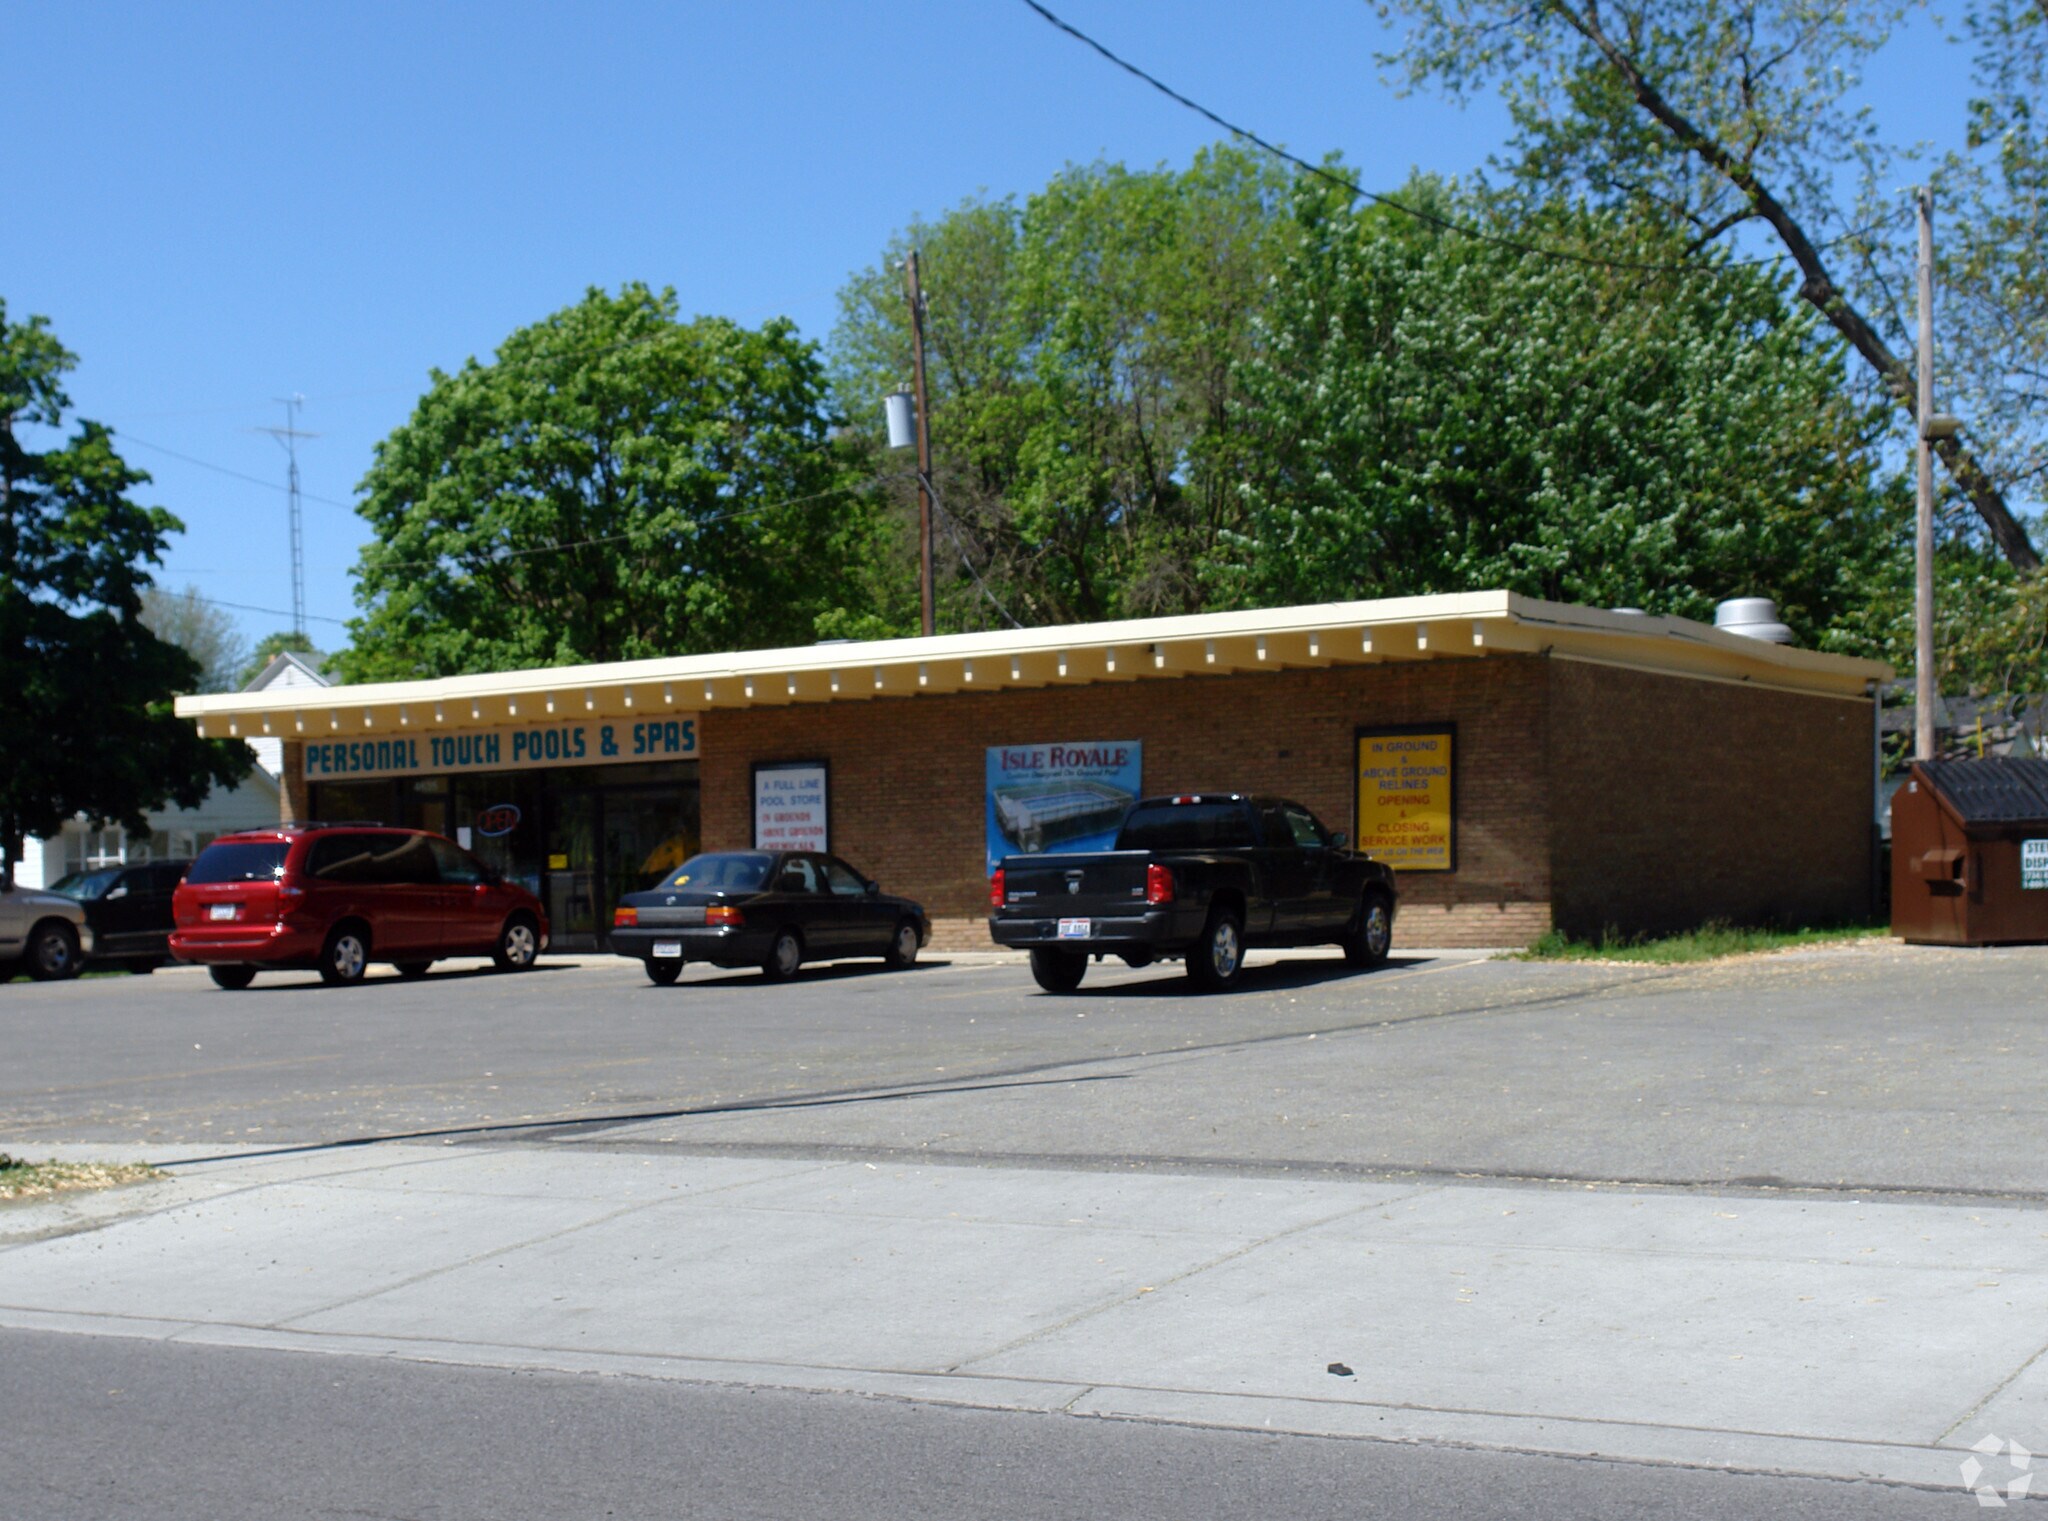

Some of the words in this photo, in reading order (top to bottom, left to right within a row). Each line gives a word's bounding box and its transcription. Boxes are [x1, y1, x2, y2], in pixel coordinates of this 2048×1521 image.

[306, 739, 419, 775] PERSONAL
[431, 733, 500, 767] TOUCH
[513, 726, 586, 762] POOLS
[601, 725, 619, 756] &
[634, 720, 696, 754] SPAS
[1372, 742, 1383, 752] IN
[1387, 741, 1438, 752] GROUND
[1001, 750, 1045, 771] ISLE
[1050, 746, 1130, 768] ROYALE
[1363, 767, 1398, 778] ABOVE
[1402, 766, 1447, 777] GROUND
[774, 780, 795, 790] FULL
[1379, 779, 1429, 790] RELINES
[760, 796, 785, 806] POOL
[790, 795, 821, 805] STORE
[1377, 795, 1430, 806] OPENING
[477, 810, 516, 831] OPEN
[1377, 822, 1430, 833] CLOSING
[1362, 835, 1409, 846] SERVICE
[1412, 834, 1446, 845] WORK
[2028, 842, 2048, 854] STE
